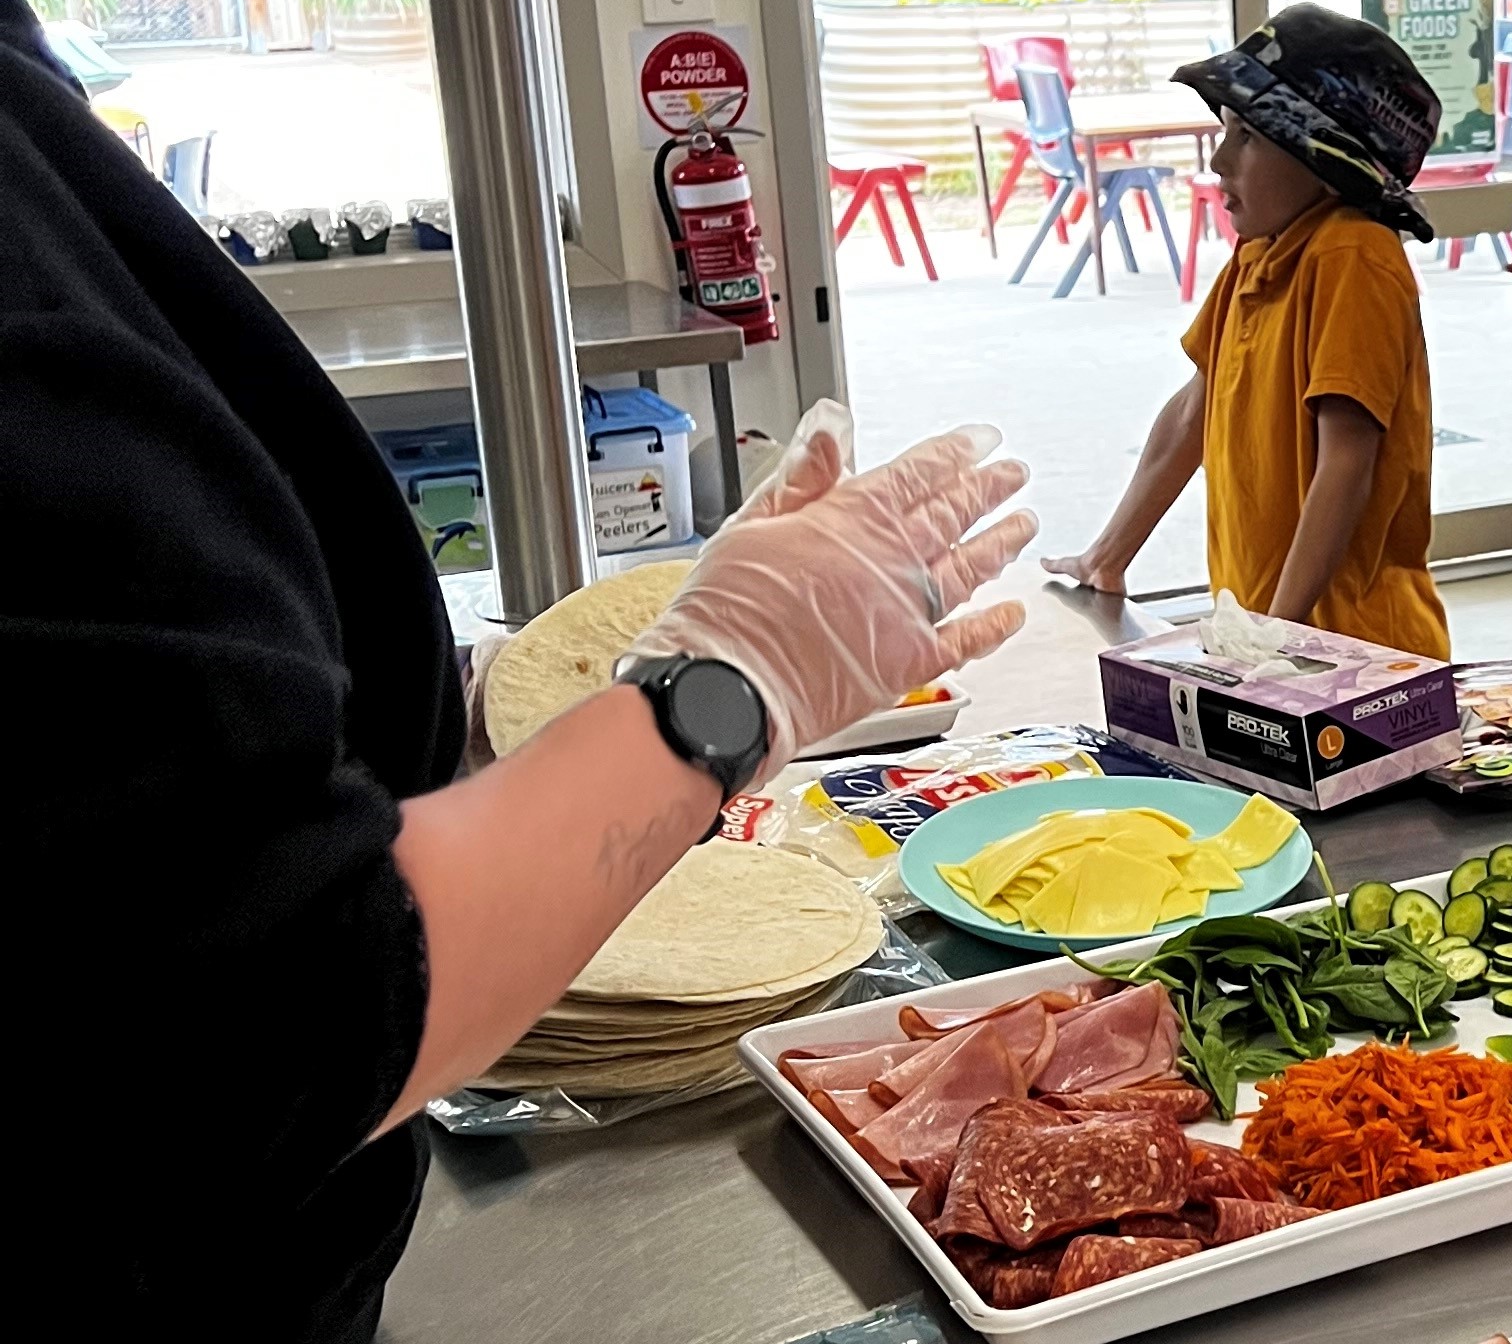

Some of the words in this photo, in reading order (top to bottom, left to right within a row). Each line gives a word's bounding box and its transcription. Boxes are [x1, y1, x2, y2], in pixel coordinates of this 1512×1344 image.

[1400, 14, 1458, 39] FOODS
[660, 67, 727, 86] POWDER
[595, 519, 650, 538] Peelers
[1387, 700, 1440, 729] VINYL
[1326, 734, 1336, 752] L
[720, 797, 766, 840] Super
